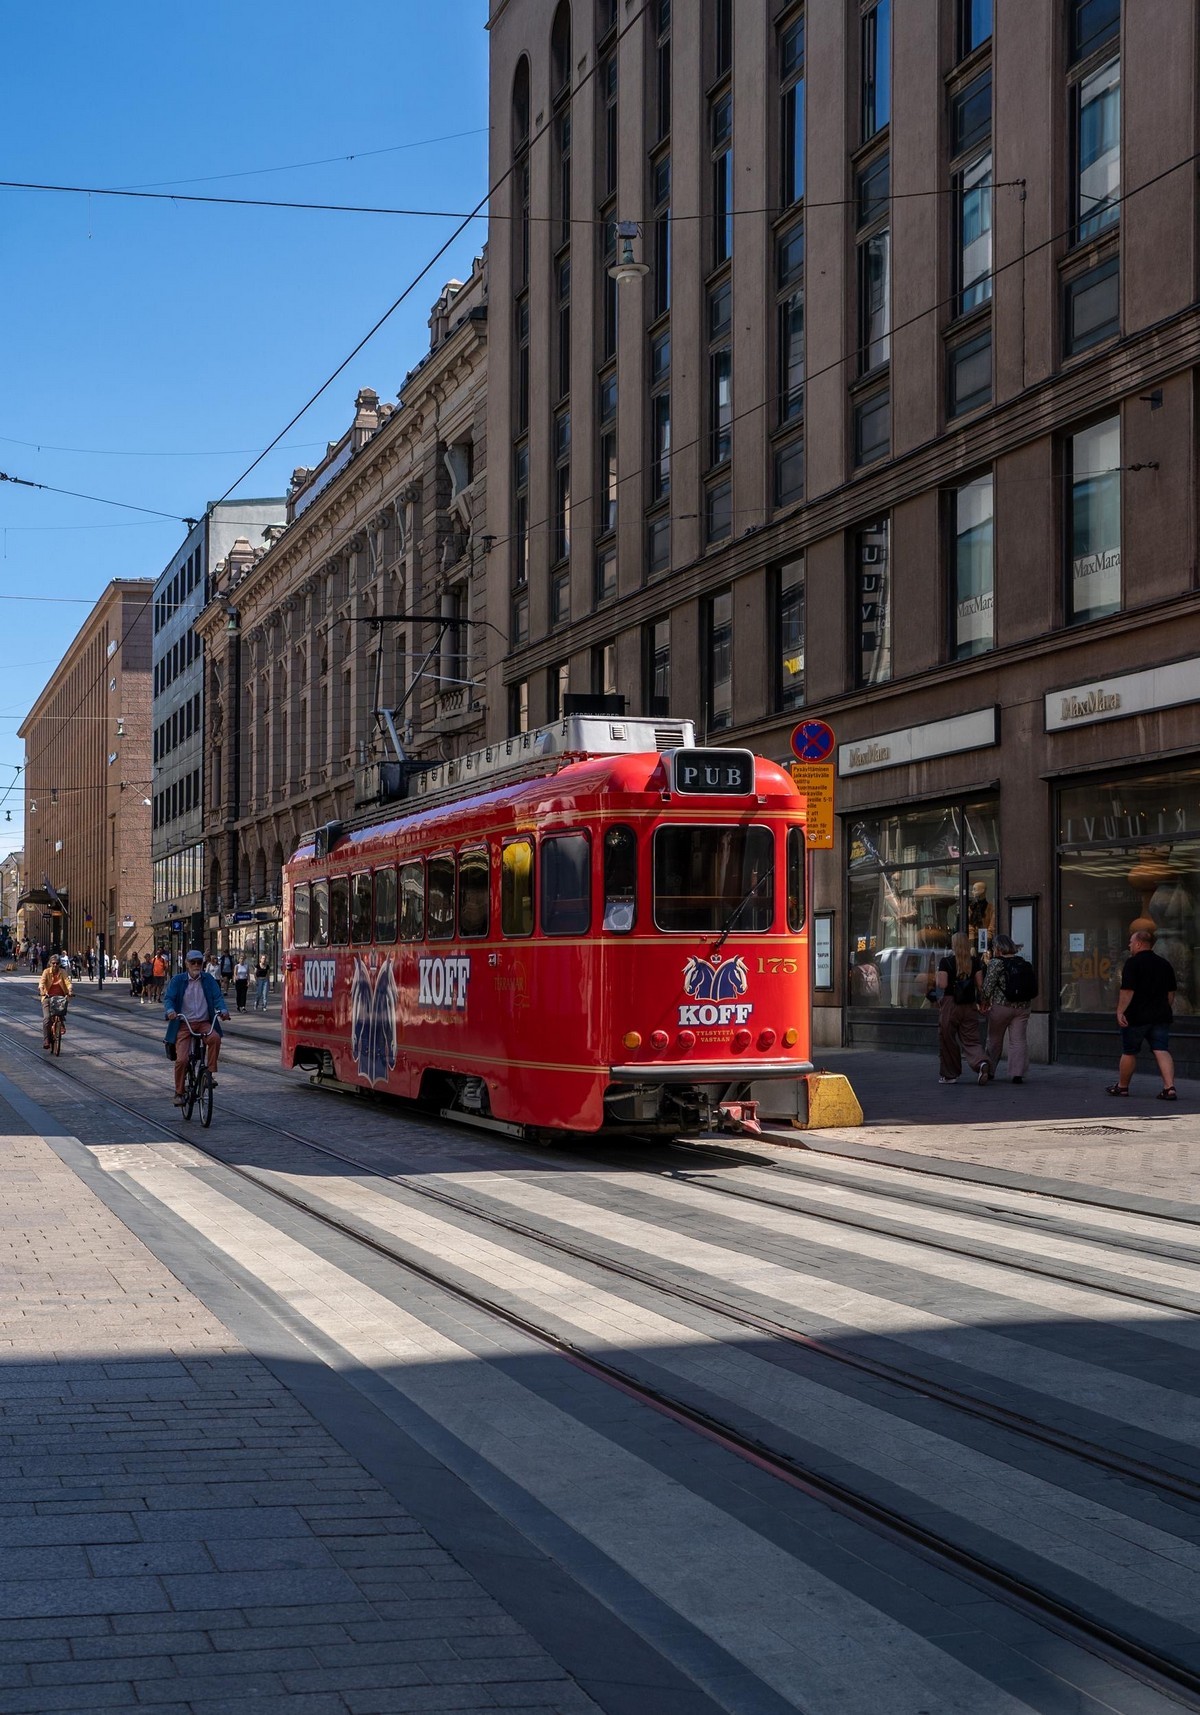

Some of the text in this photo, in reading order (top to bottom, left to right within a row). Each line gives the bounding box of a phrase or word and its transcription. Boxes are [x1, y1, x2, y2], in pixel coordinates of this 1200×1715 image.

[1073, 552, 1121, 579] MaxMara
[1060, 689, 1121, 720] MaxMara
[848, 743, 890, 768] MaxMara
[684, 767, 742, 786] PUB
[757, 957, 798, 974] 175
[1071, 944, 1112, 980] sale
[303, 960, 336, 998] KOFF
[418, 958, 471, 1007] KOFF
[678, 1004, 753, 1026] KOFF
